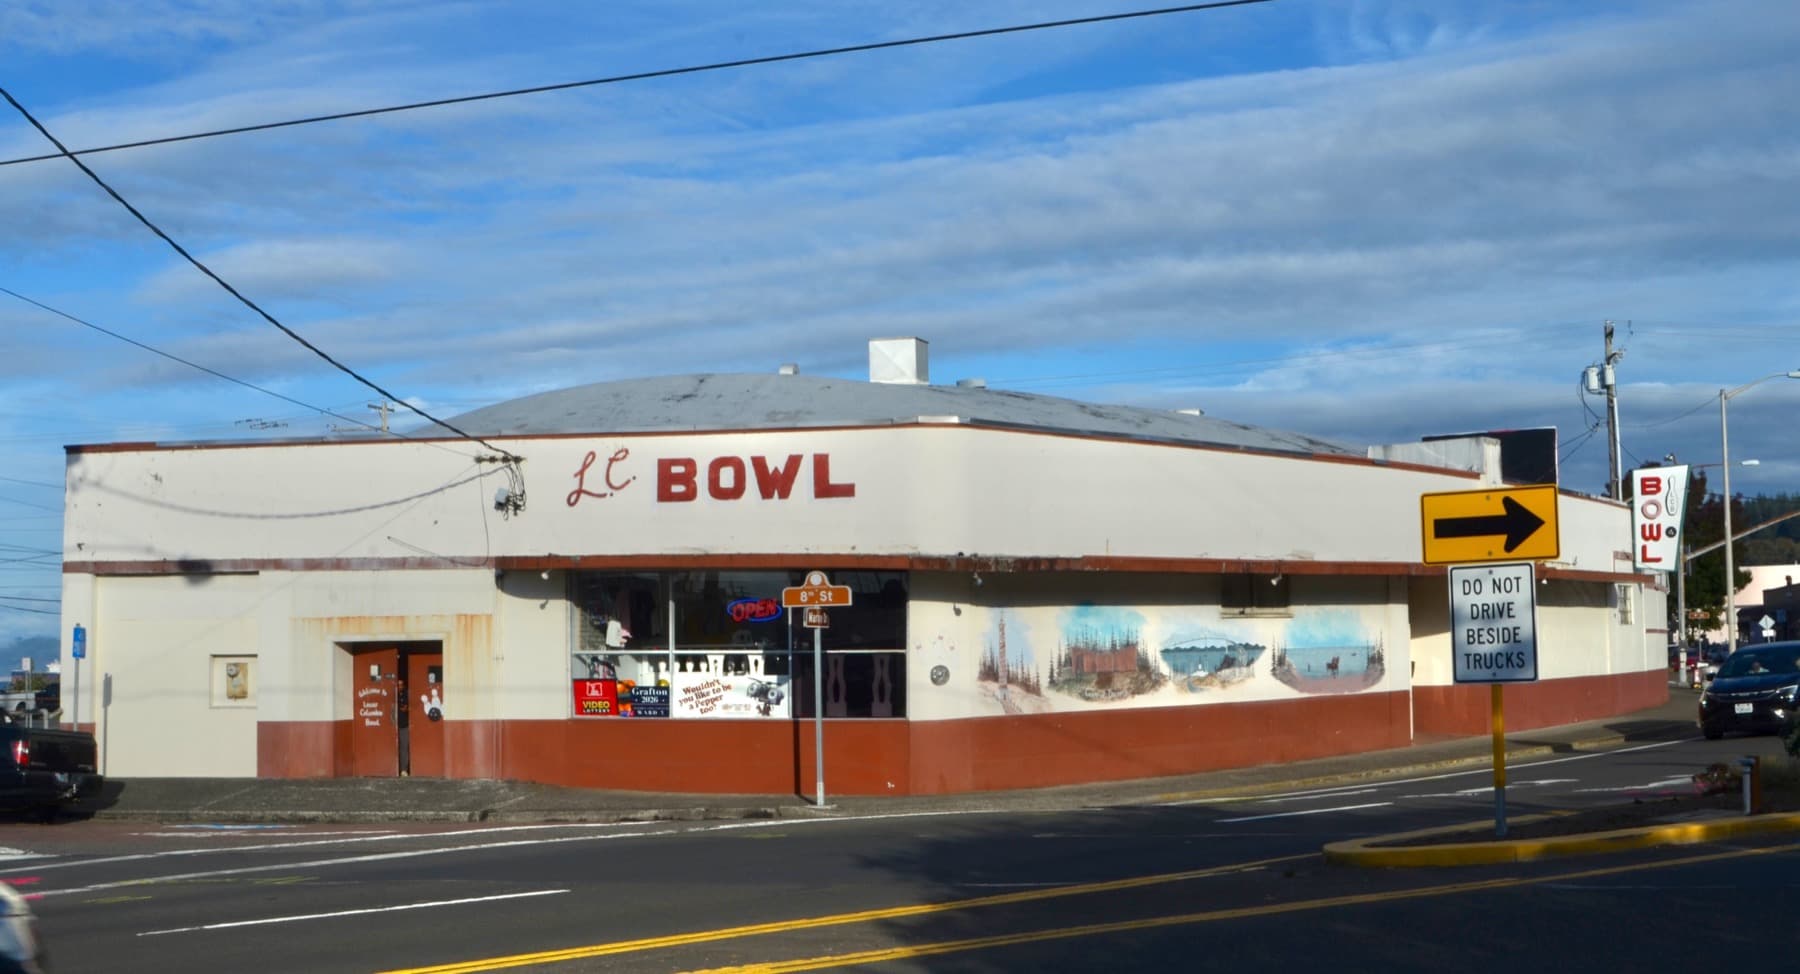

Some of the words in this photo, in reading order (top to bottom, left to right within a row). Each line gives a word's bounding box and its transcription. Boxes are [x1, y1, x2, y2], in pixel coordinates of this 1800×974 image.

[656, 453, 856, 502] BOWL
[1640, 476, 1663, 563] BOWL
[1462, 578, 1483, 596] DO
[1492, 576, 1522, 594] NOT
[820, 590, 833, 602] St
[732, 598, 777, 622] OPEN
[1470, 601, 1516, 620] DRIVE
[1466, 626, 1522, 646] BESIDE
[1463, 651, 1526, 670] TRUCKS
[632, 687, 668, 696] Grafton
[678, 696, 694, 707] you
[694, 690, 711, 700] like
[712, 687, 722, 695] to
[721, 684, 733, 692] be
[682, 679, 721, 695] Wouldn't
[582, 700, 610, 709] VIDEO
